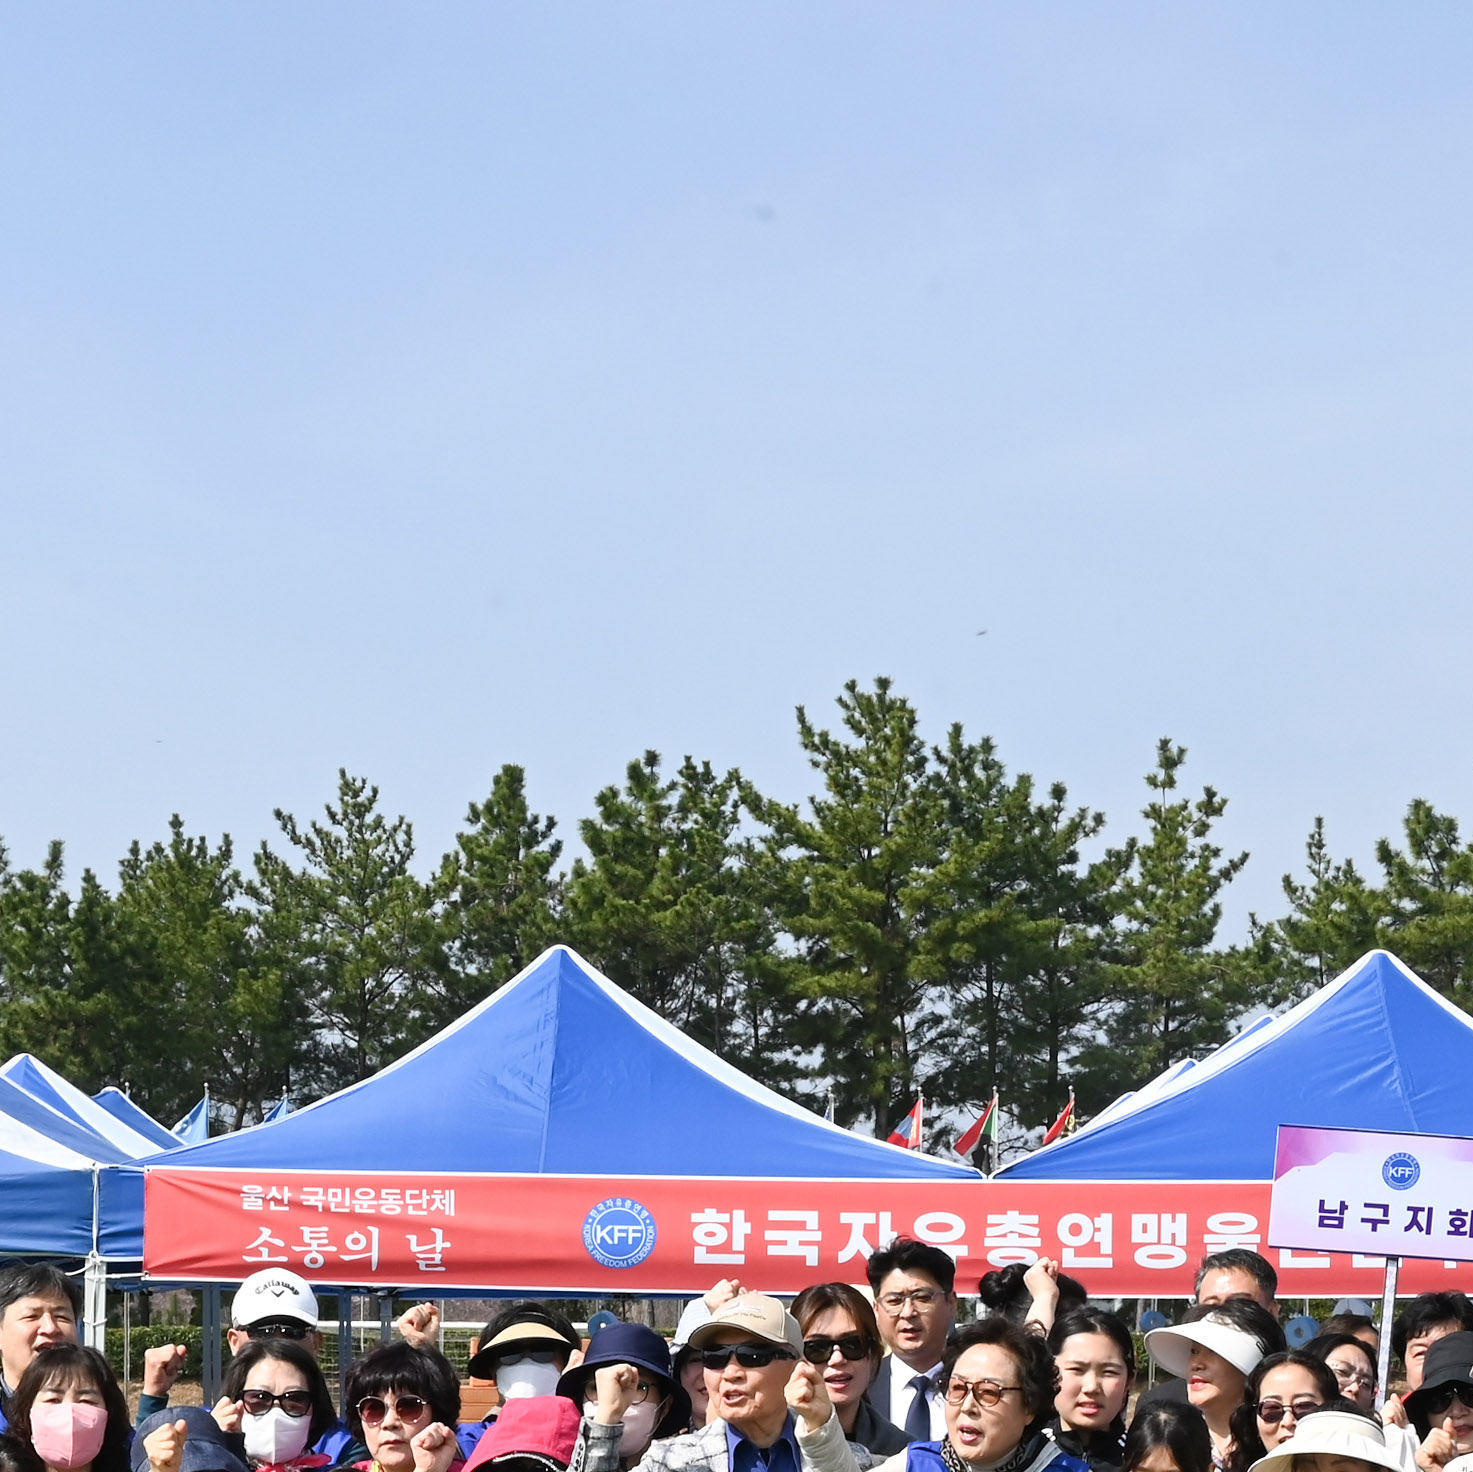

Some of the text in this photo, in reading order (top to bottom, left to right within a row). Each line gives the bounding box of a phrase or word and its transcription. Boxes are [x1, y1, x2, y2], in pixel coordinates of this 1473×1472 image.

[1389, 1166, 1415, 1178] KFF
[240, 1185, 456, 1216] 울산 국민운동단체
[596, 1225, 643, 1245] KFF
[242, 1226, 452, 1272] 소통의 날
[255, 1280, 300, 1297] Callaway
